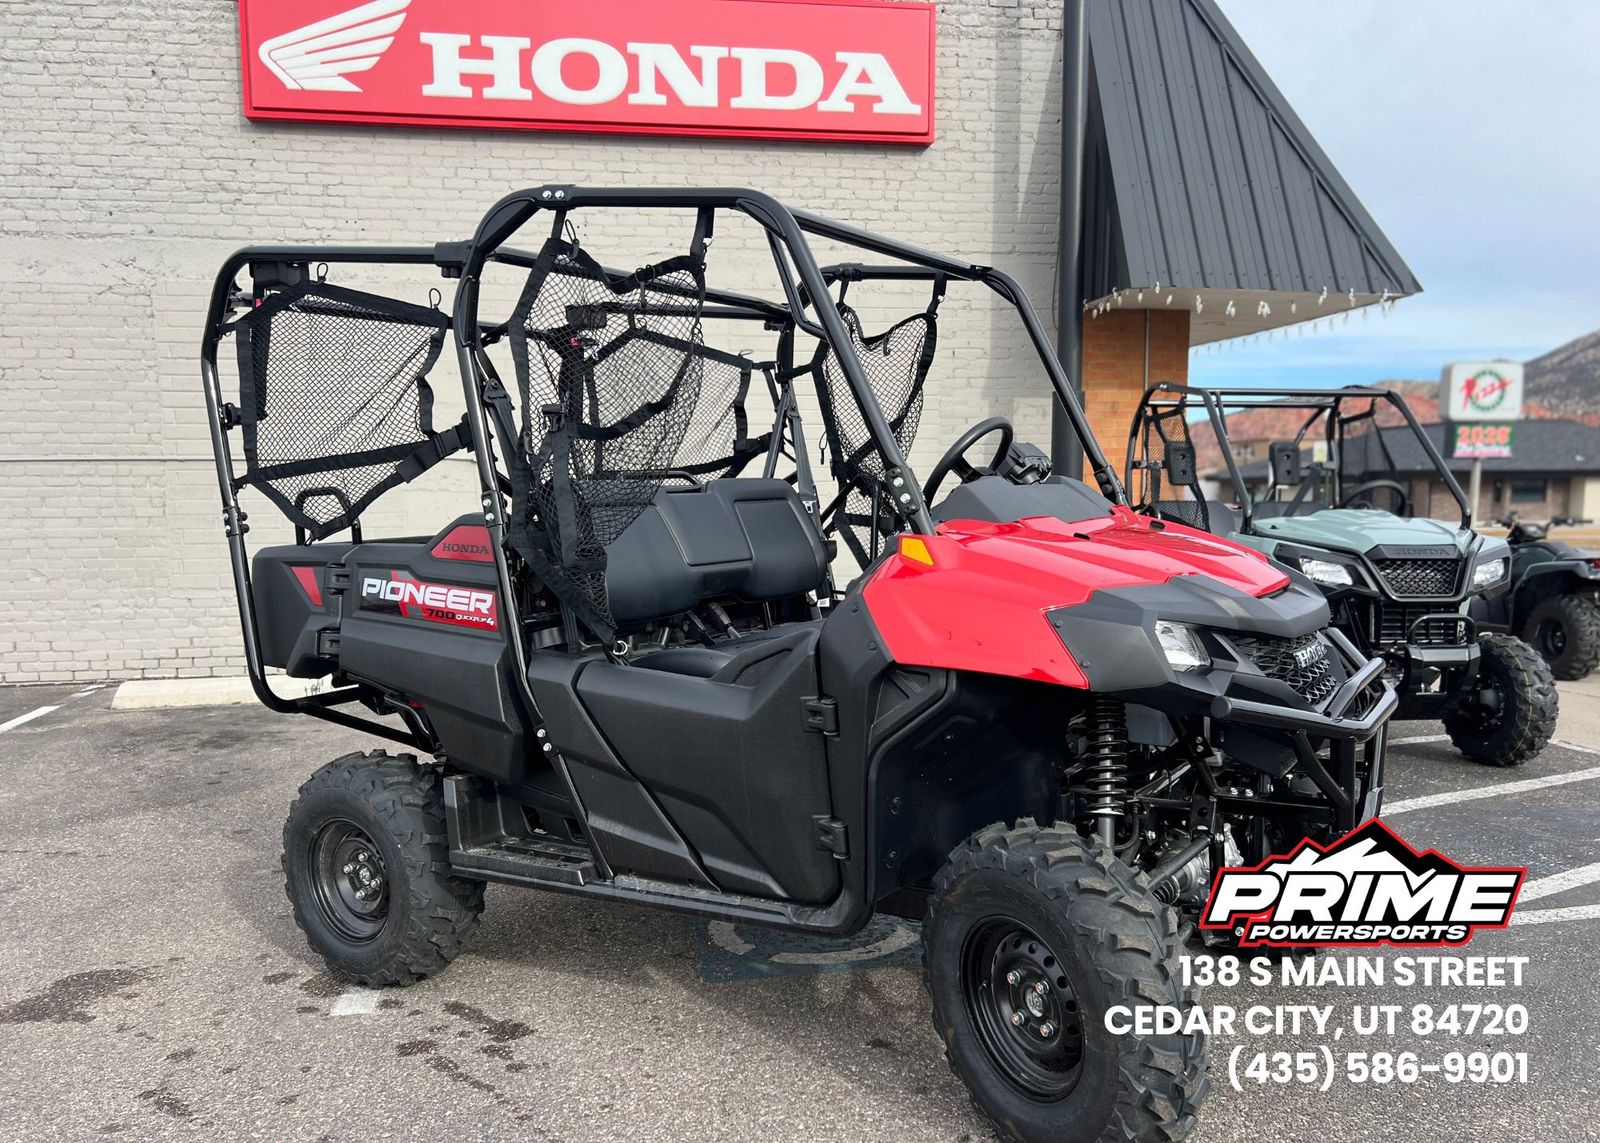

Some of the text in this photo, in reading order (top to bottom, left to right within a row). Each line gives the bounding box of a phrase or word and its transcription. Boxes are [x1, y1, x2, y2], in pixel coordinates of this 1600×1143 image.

[420, 32, 921, 115] HONDA
[442, 543, 490, 555] HONDA
[361, 577, 494, 615] PIONEER
[425, 608, 456, 620] 700
